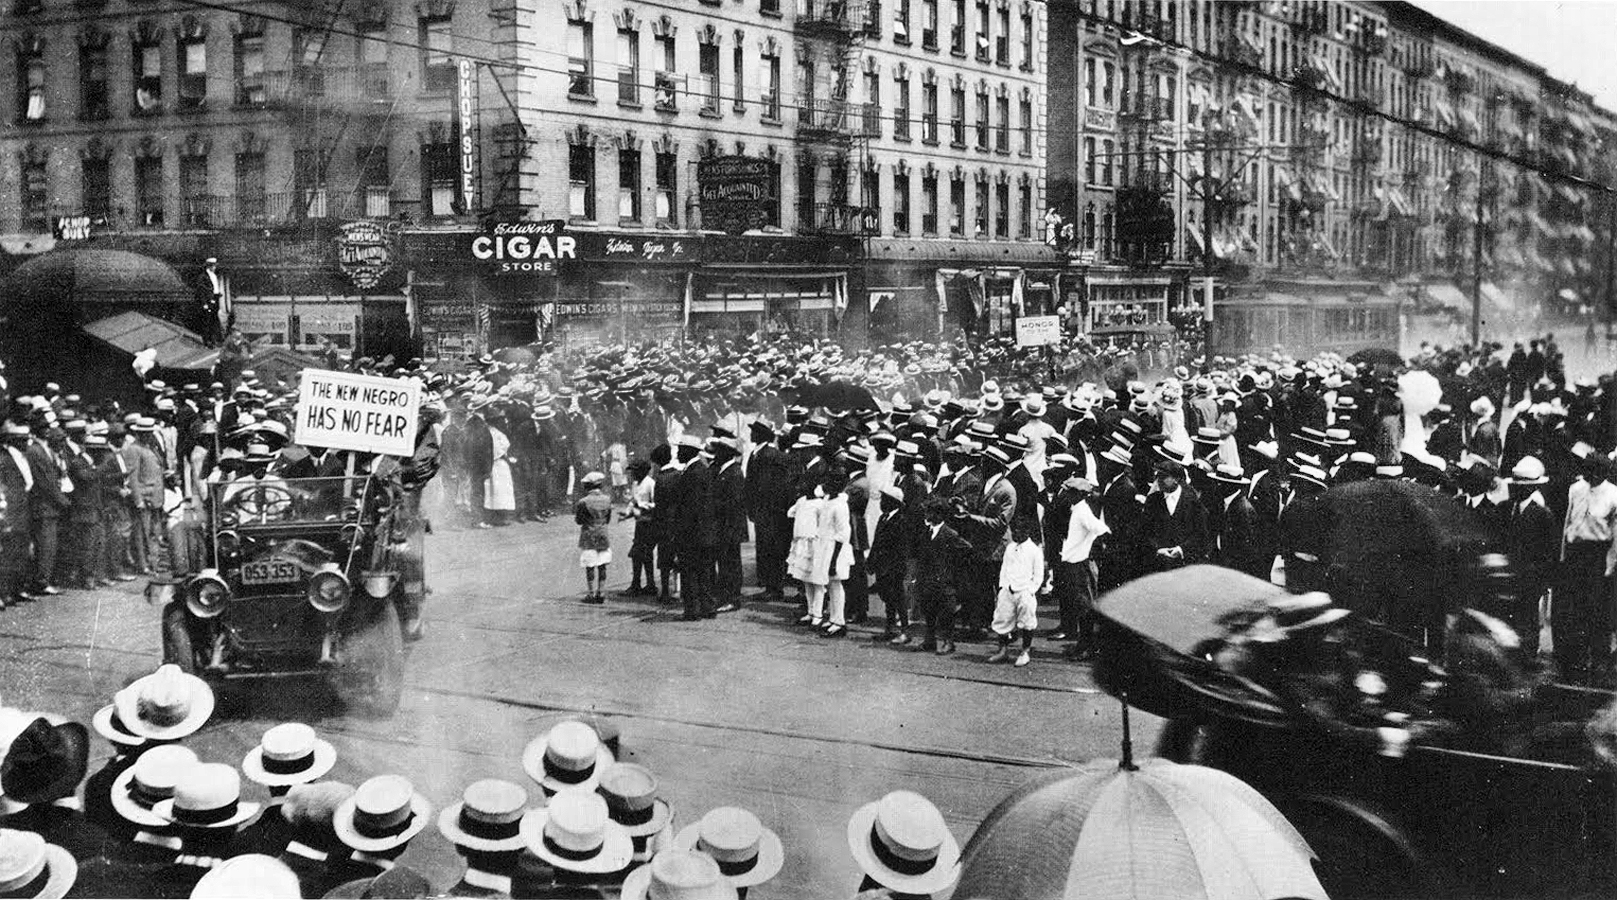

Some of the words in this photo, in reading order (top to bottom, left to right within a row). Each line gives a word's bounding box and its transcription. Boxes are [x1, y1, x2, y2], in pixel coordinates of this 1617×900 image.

[460, 60, 472, 134] CHOP
[463, 136, 474, 210] SUEY
[494, 223, 555, 235] Edwin's
[472, 236, 576, 259] CIGAR
[502, 263, 552, 272] STORE
[588, 303, 618, 314] CIGARS
[312, 381, 333, 399] THE
[336, 384, 360, 402] NEW
[363, 387, 409, 408] NEGRO
[307, 405, 337, 430] HAS
[341, 409, 362, 433] NO
[365, 412, 408, 438] FEAR
